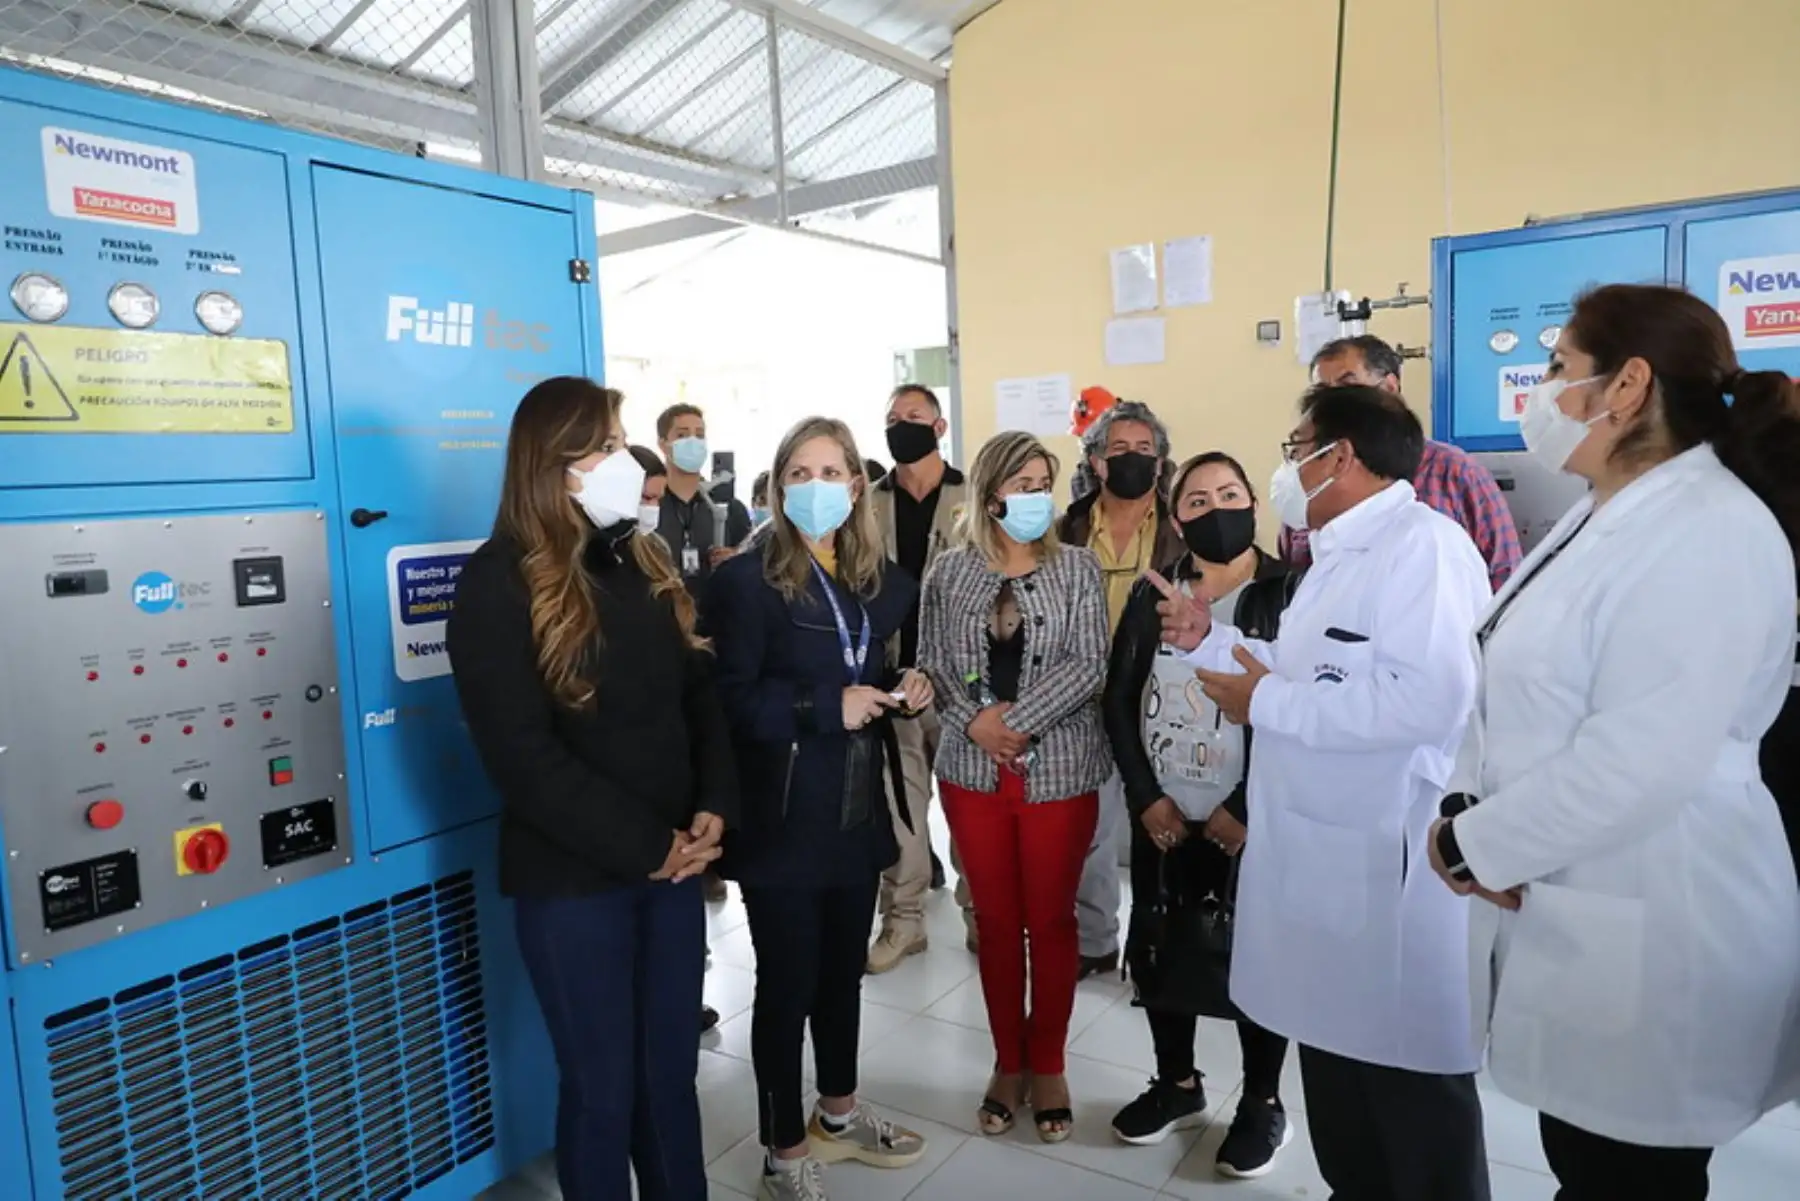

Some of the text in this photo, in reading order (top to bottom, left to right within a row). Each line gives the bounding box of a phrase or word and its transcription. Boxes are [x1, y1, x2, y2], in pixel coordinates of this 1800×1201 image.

[55, 134, 180, 175] Newmont
[78, 190, 173, 218] Yanacocha
[4, 240, 64, 255] ENTRADA
[386, 295, 474, 347] Full
[1752, 308, 1800, 326] Yan
[75, 348, 148, 364] PELIGRO
[406, 566, 446, 581] Nuestro
[134, 582, 173, 604] Full
[364, 708, 395, 730] Full
[284, 818, 314, 839] SAC
